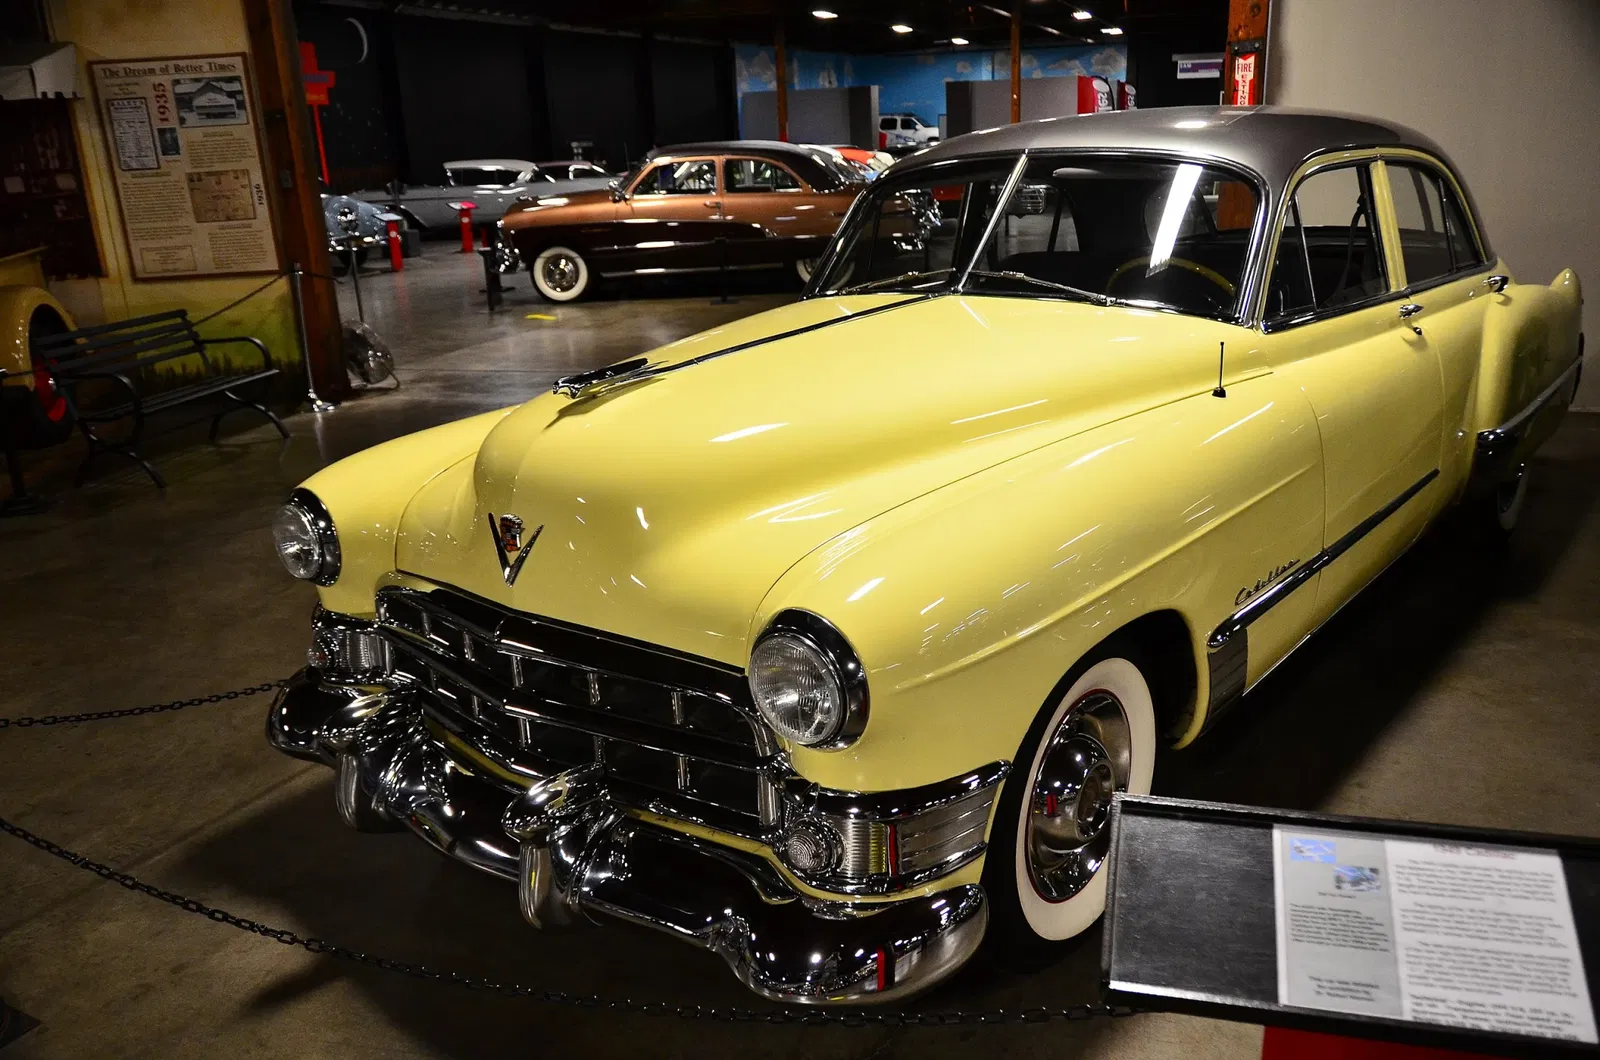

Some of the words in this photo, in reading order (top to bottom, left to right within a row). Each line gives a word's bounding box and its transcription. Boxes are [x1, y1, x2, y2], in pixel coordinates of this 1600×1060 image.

[101, 67, 120, 77] The
[124, 66, 156, 76] Dream
[159, 64, 171, 74] of
[174, 62, 204, 73] Better
[208, 61, 237, 72] Times
[1237, 62, 1252, 73] FIRE
[152, 82, 171, 123] 1935
[254, 184, 265, 206] 1936
[1234, 558, 1301, 606] Cadillac
